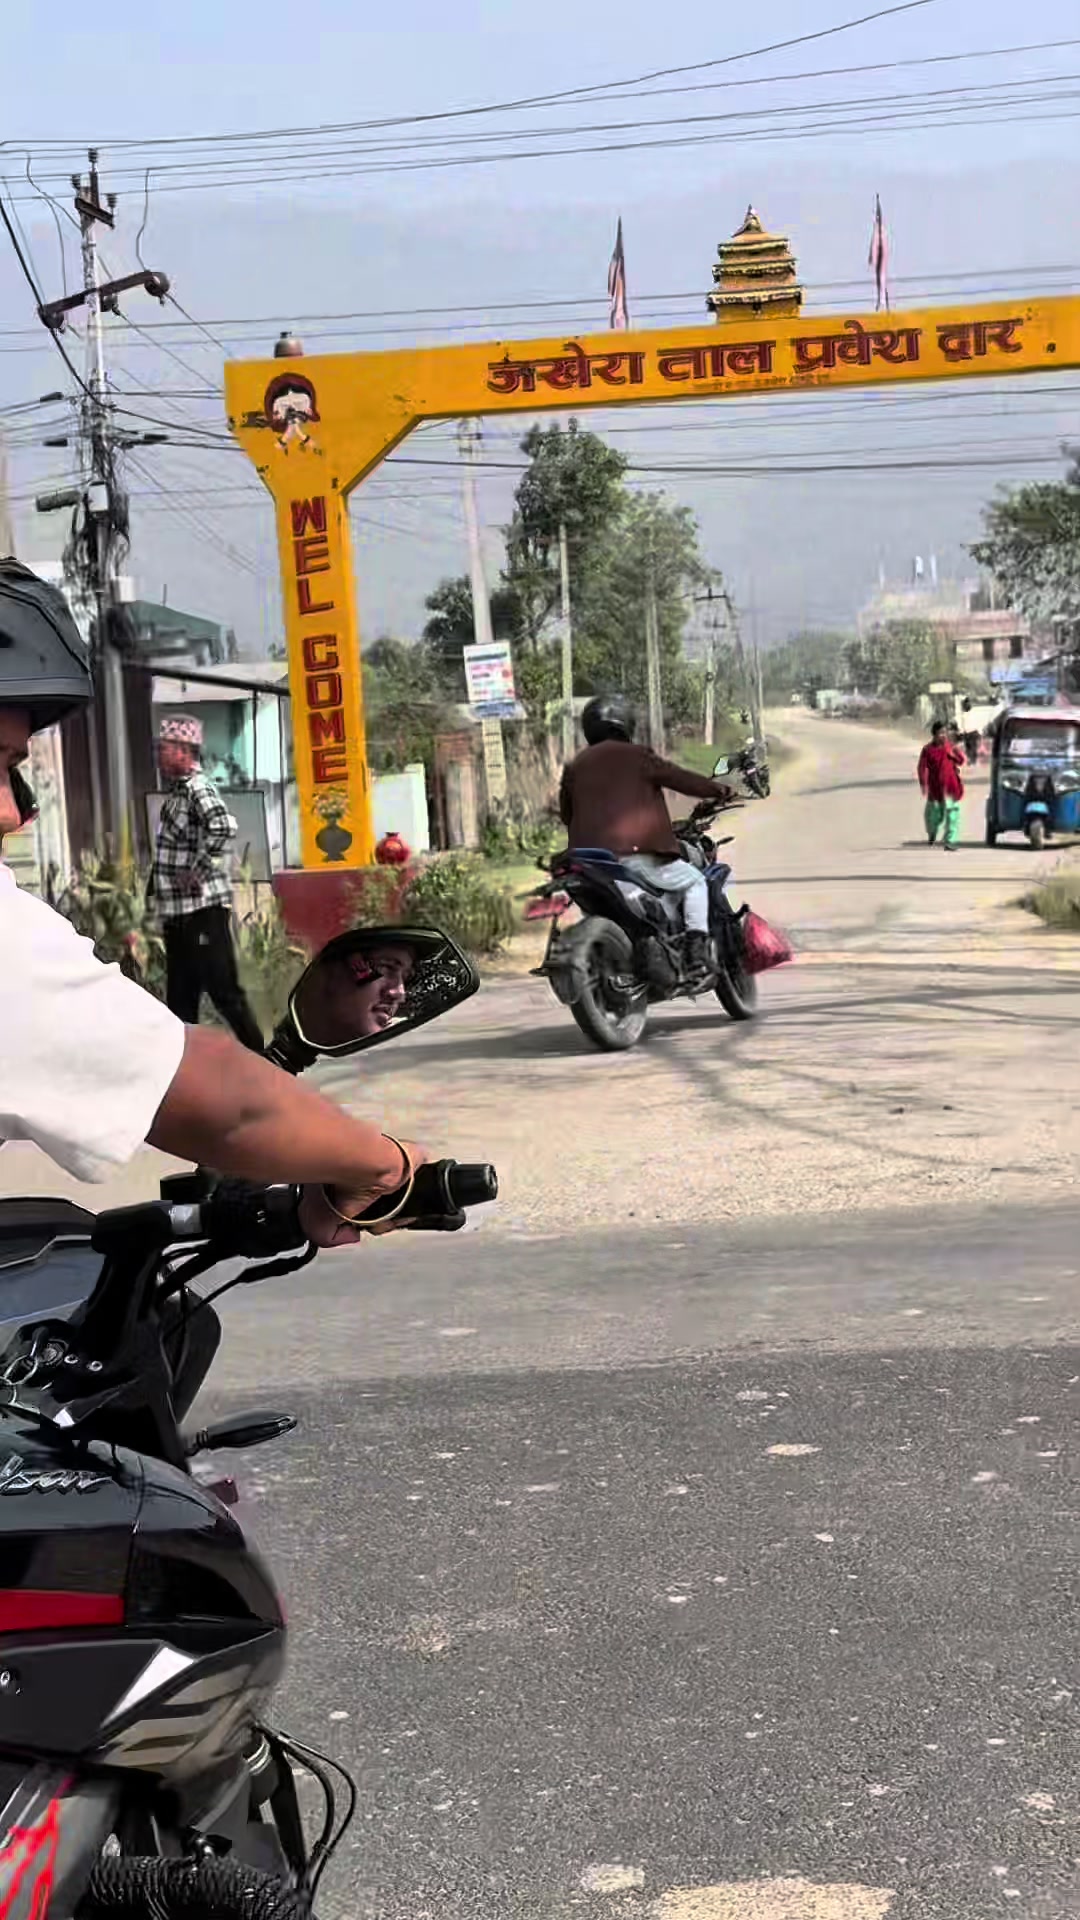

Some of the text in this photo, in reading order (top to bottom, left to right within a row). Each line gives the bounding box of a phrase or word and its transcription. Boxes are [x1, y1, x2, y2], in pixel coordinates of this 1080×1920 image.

[656, 340, 777, 382] ताल
[791, 319, 923, 374] प्रवेश
[936, 318, 1024, 362] द्वार
[290, 496, 349, 784] WEL COME
